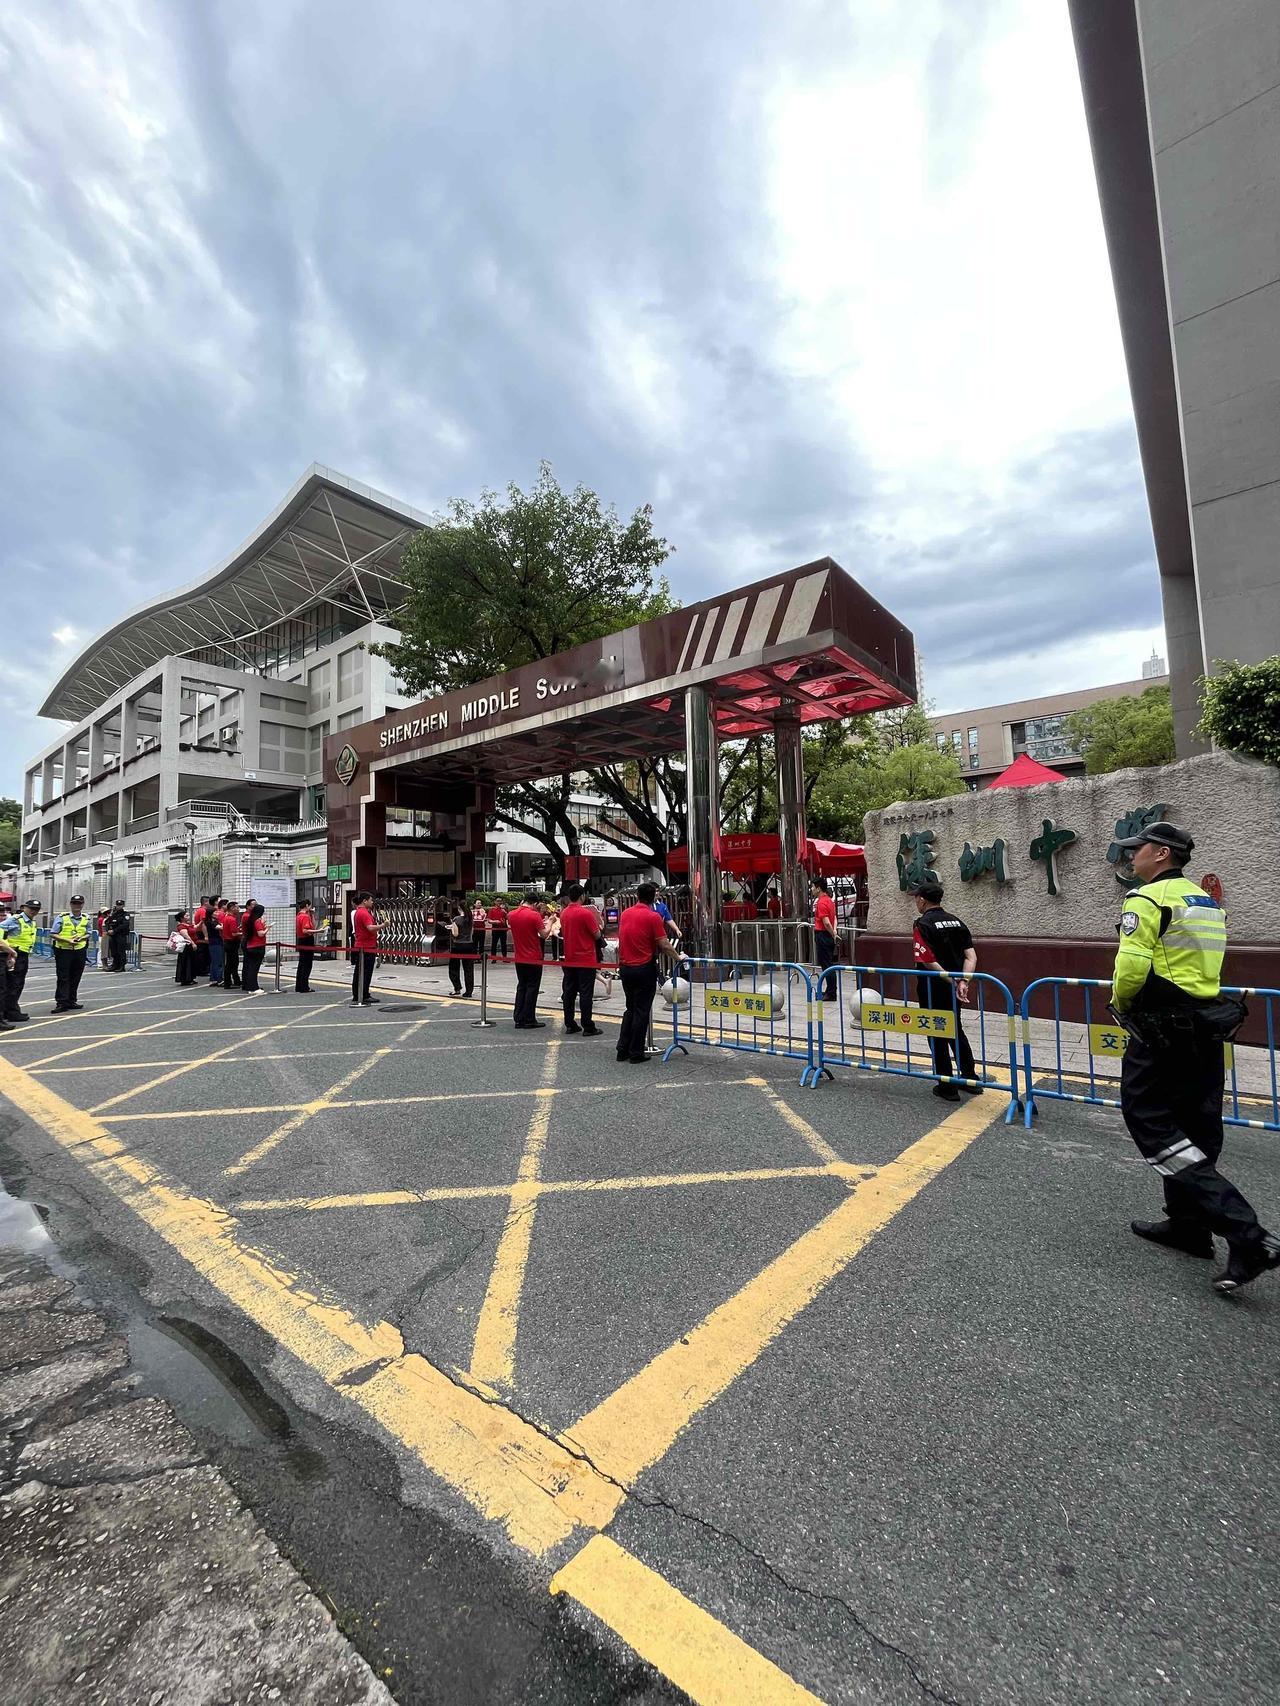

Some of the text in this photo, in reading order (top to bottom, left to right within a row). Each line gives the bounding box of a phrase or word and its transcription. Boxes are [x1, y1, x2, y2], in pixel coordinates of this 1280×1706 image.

[379, 710, 448, 748] SHENZHEN
[461, 686, 520, 723] MIDDLE
[710, 995, 766, 1012] 交通 管制
[868, 1009, 948, 1031] 深圳 交警
